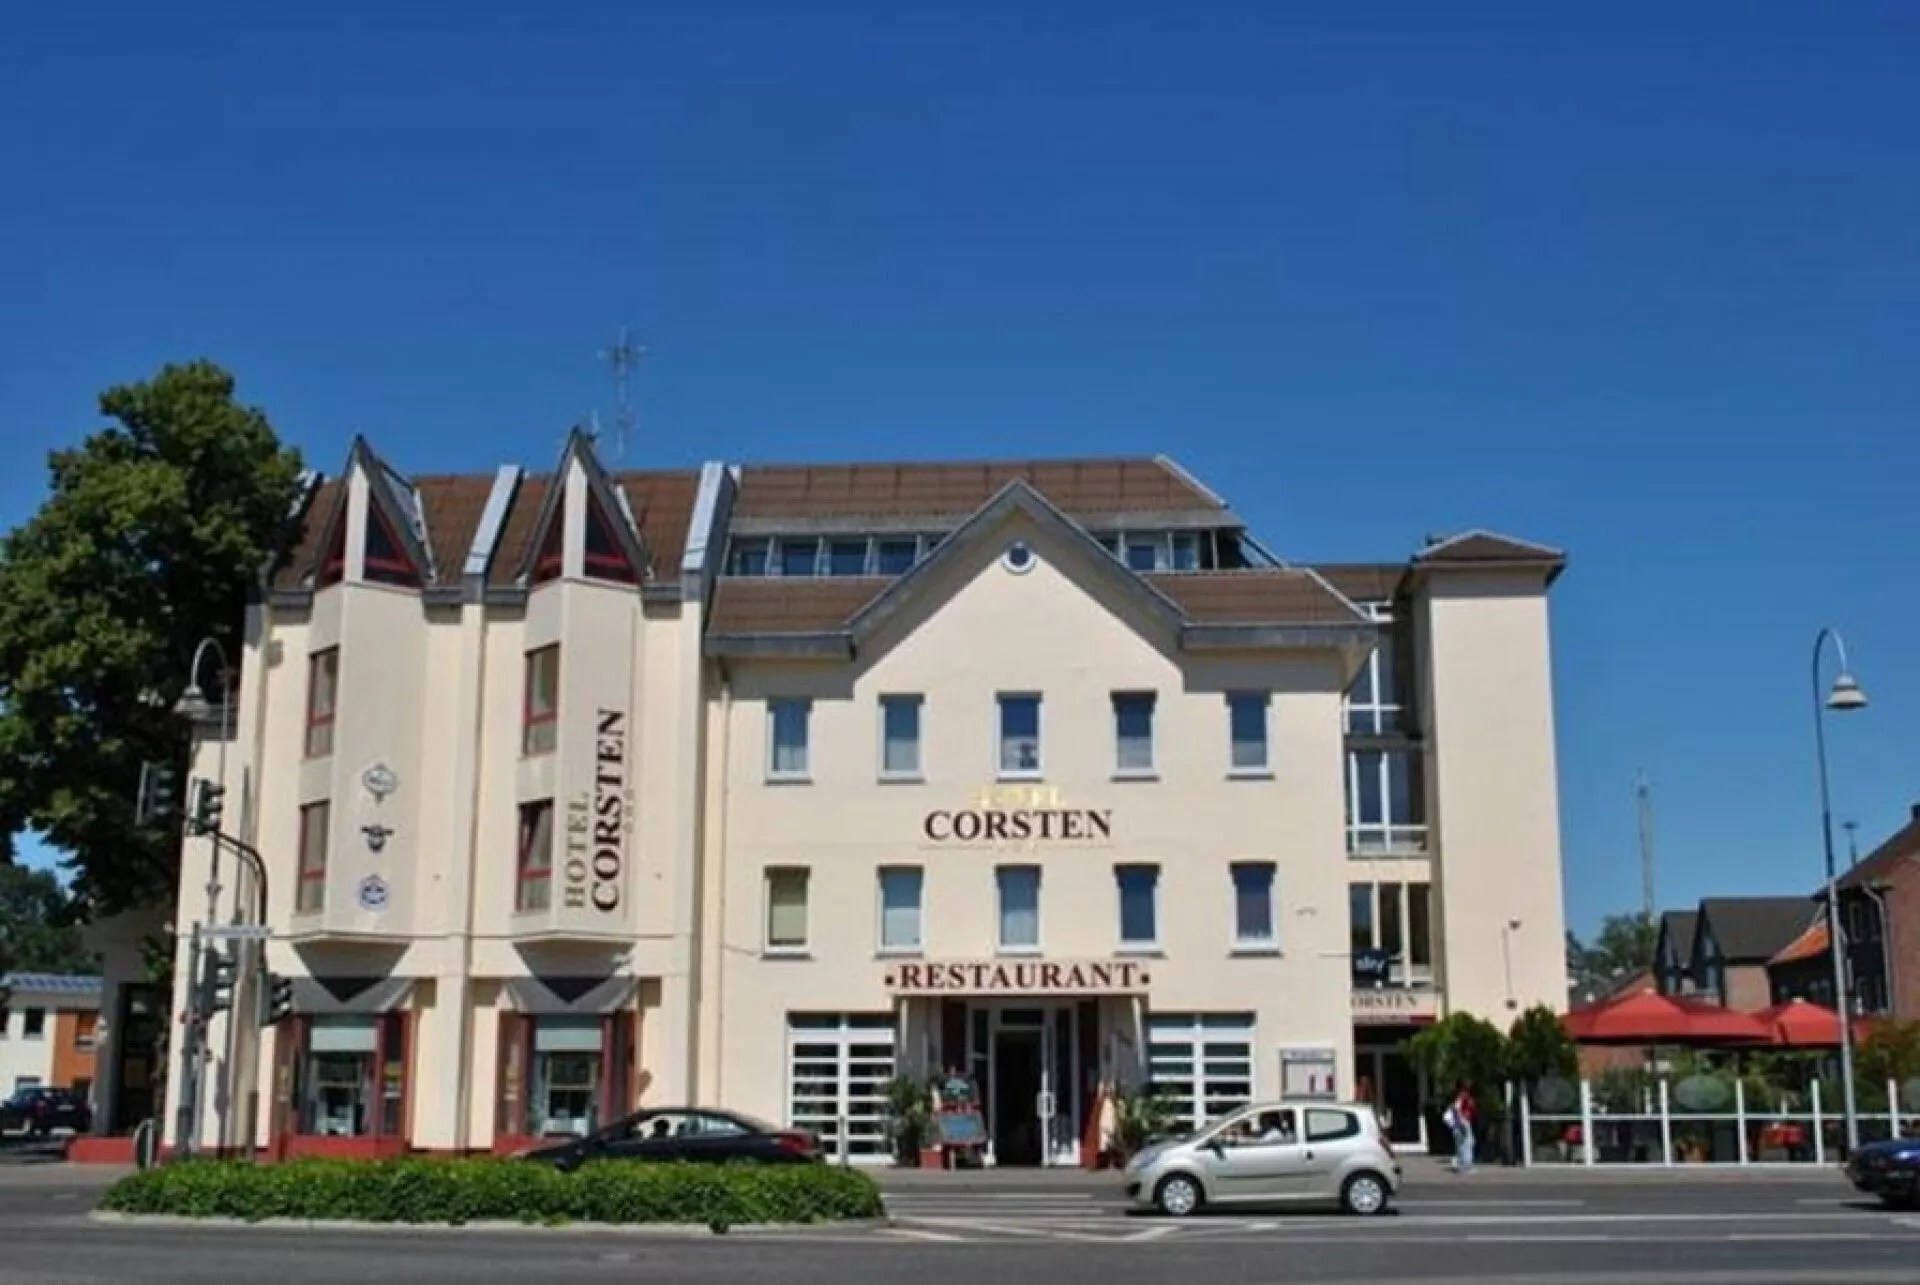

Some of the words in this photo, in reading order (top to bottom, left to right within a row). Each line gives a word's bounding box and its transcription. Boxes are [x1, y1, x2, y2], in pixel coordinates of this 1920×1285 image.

[592, 707, 625, 912] CORSTEN
[924, 809, 1113, 841] CORSTEN
[564, 791, 589, 908] HOTEL
[898, 962, 1139, 990] RESTAURANT
